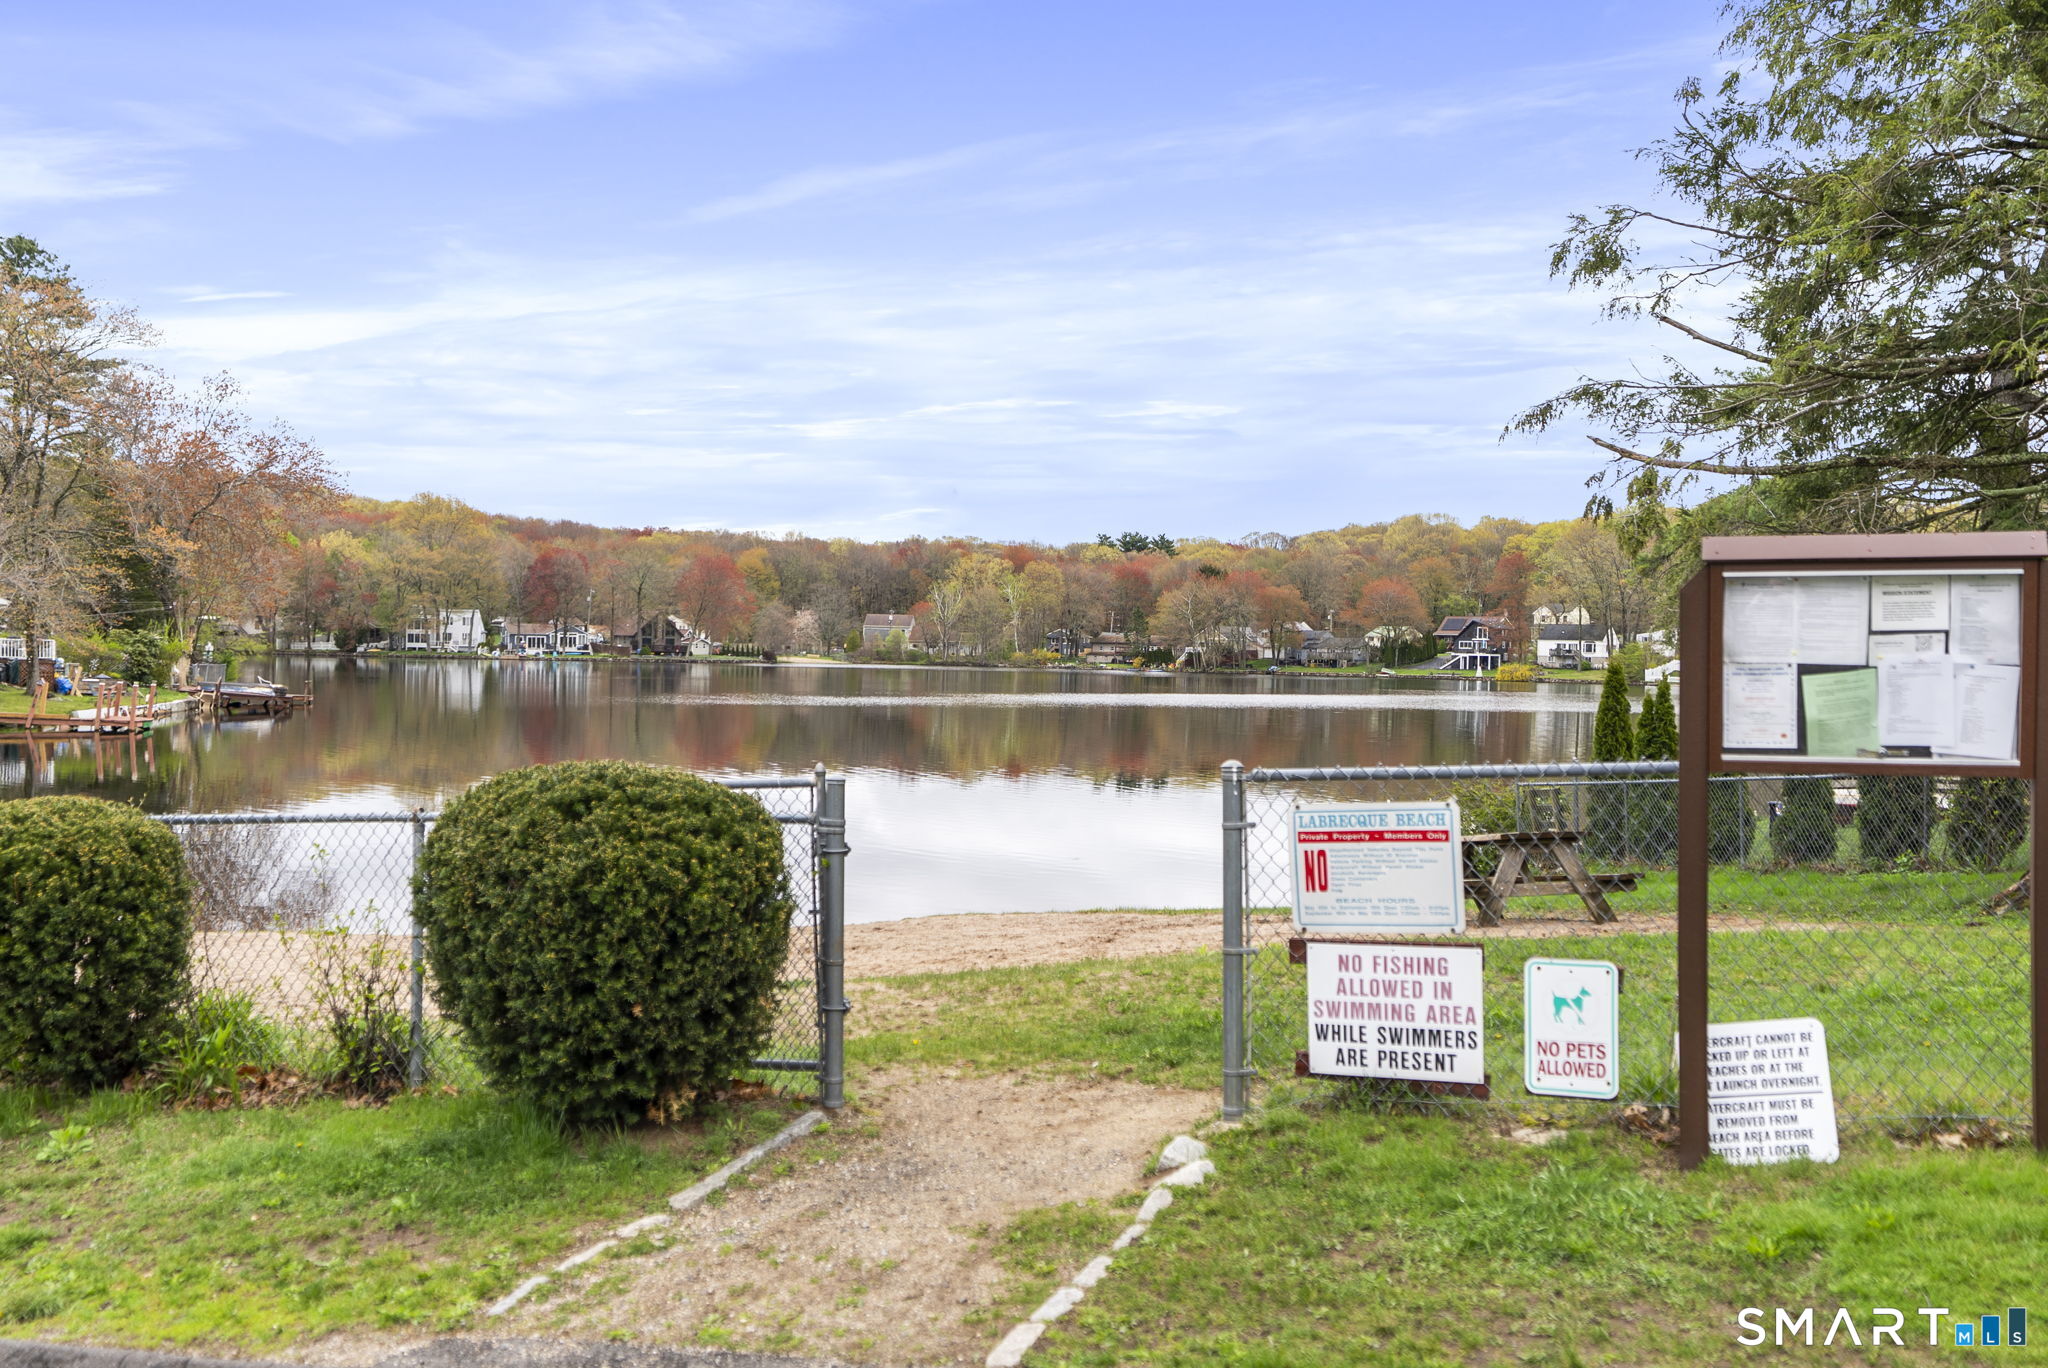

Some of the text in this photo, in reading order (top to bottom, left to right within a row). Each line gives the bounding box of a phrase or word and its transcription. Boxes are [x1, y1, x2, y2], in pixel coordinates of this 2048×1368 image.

[1299, 813, 1446, 828] LABRECQUE BEACH
[1300, 833, 1328, 841] Private
[1333, 833, 1370, 842] Property
[1384, 832, 1423, 840] Members
[1427, 832, 1447, 841] Only
[1304, 849, 1328, 893] NO
[1338, 954, 1449, 977] NO FISHING
[1336, 978, 1453, 1001] ALLOWED IN
[1313, 1000, 1477, 1025] SWIMMING AREA
[1315, 1023, 1478, 1050] WHILE SWIMMERS
[1756, 1033, 1797, 1045] CANNOT
[1800, 1032, 1813, 1043] BE
[1537, 1041, 1607, 1060] NO PETS
[1735, 1050, 1749, 1061] UP
[1753, 1049, 1768, 1060] OR
[1771, 1048, 1794, 1059] LEFT
[1798, 1047, 1810, 1057] AT
[1336, 1047, 1458, 1073] ARE PRESENT
[1537, 1060, 1606, 1078] ALLOWED
[1708, 1062, 1804, 1077] EACHES OR AT THE
[1716, 1079, 1757, 1091] LAUNCH
[1708, 1098, 1815, 1114] ATERCRAFT MUST BE
[1716, 1115, 1798, 1129] REMOVED FROM
[1744, 1131, 1771, 1143] AREA
[1775, 1129, 1815, 1141] BEFORE
[1746, 1146, 1765, 1157] ARE
